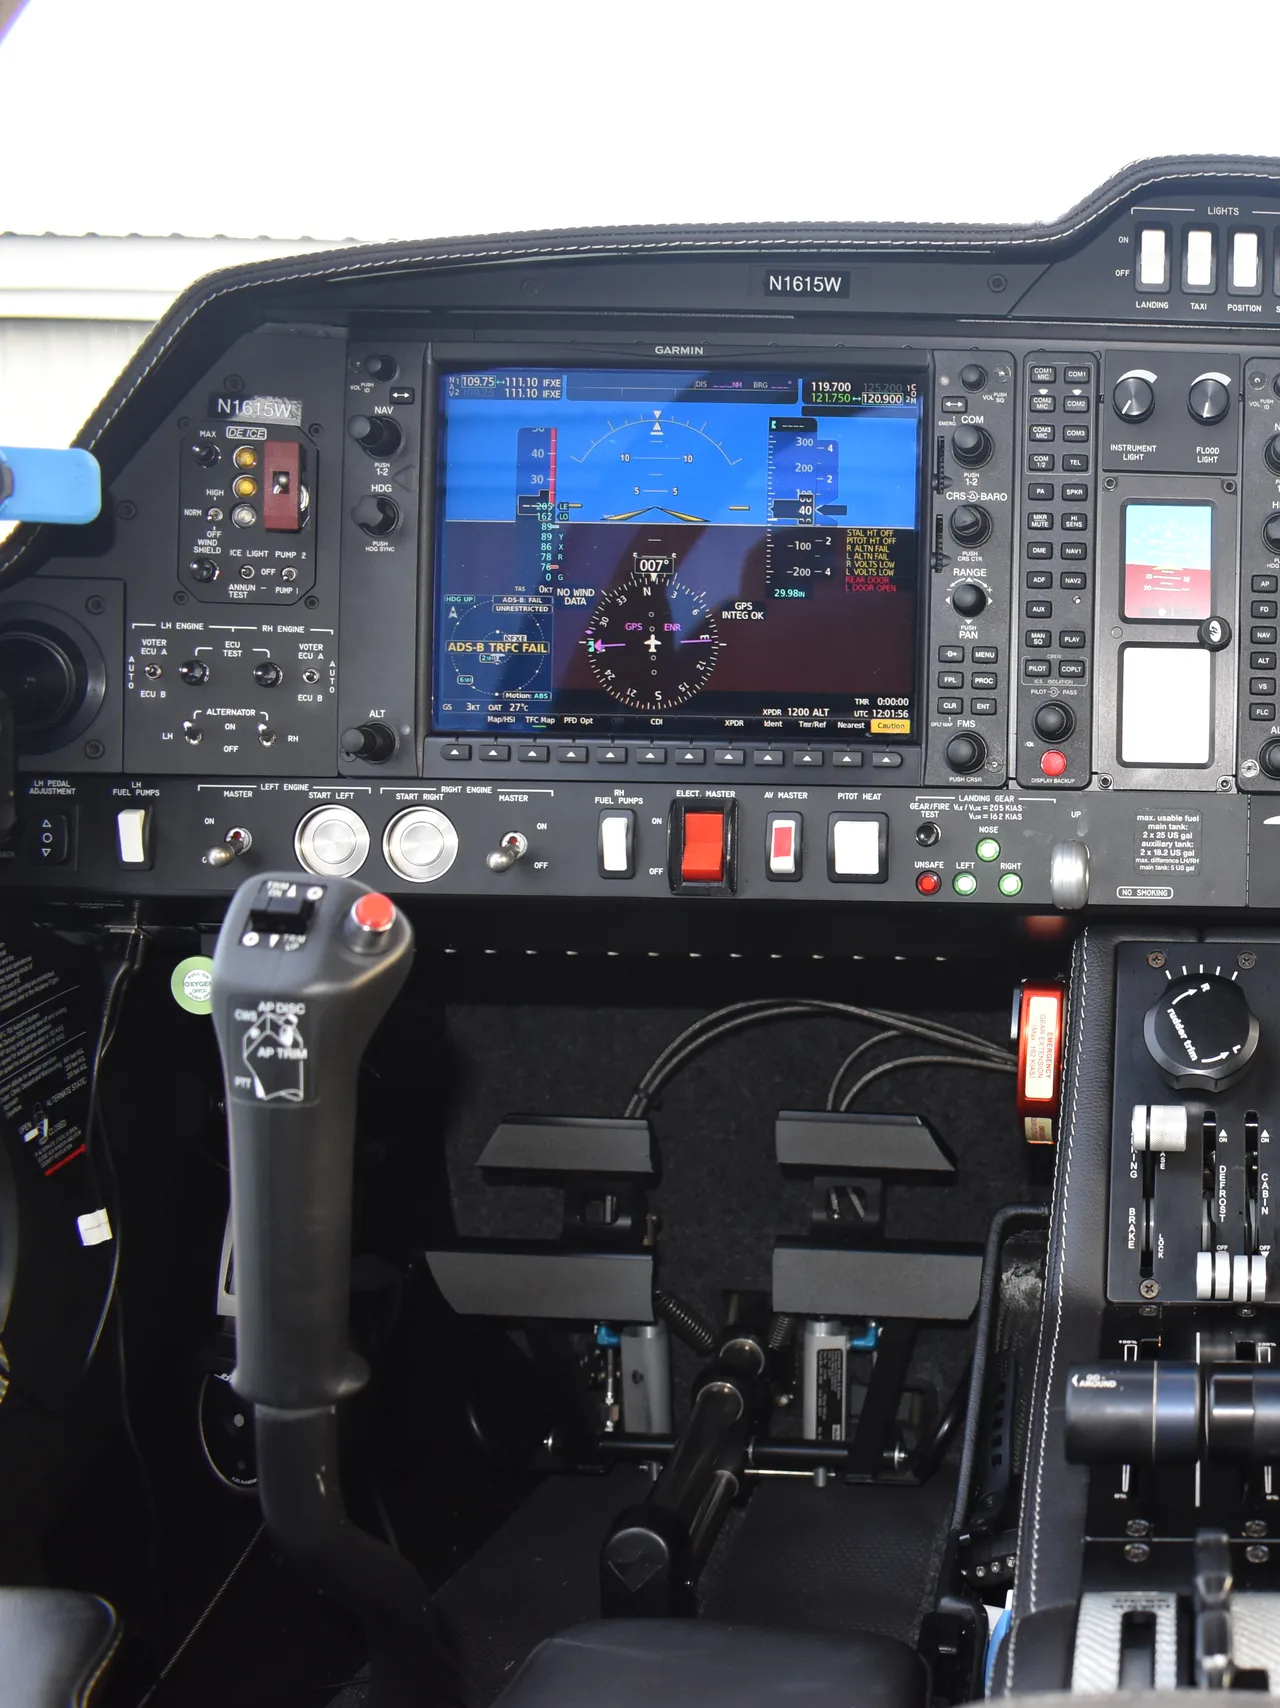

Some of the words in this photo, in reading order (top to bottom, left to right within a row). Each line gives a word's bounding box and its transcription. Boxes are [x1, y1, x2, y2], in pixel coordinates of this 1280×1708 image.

[1208, 206, 1239, 216] LIGHTS
[1115, 269, 1130, 277] OFF
[770, 275, 842, 292] N1615W
[1136, 301, 1169, 309] LANDING
[1190, 302, 1207, 310] TAXI
[1227, 304, 1262, 312] POSITION
[655, 346, 703, 355] GARMIN
[812, 382, 851, 392] 119.700
[218, 396, 292, 418] N1615W
[374, 406, 394, 414] NAV
[961, 415, 984, 424] COM
[1110, 444, 1157, 452] INSTRUMENT
[1196, 446, 1220, 455] FLOOD
[1123, 453, 1144, 461] LIGHT
[371, 484, 392, 492] HDG
[946, 492, 966, 500] CRS
[980, 492, 1008, 501] BARO
[206, 530, 222, 538] OFF
[193, 546, 221, 554] SHIELD
[230, 549, 242, 557] ICE
[953, 568, 987, 577] RANGE
[735, 602, 753, 610] GPS
[722, 611, 748, 619] INTEG
[751, 611, 764, 620] OK
[176, 622, 203, 630] ENGINE
[277, 625, 304, 633] ENGINE
[959, 630, 978, 639] PAN
[448, 642, 484, 652] ADS-B
[488, 643, 519, 652] TRFC
[522, 643, 547, 653] FAIL
[206, 708, 256, 716] ALTERNATOR
[369, 709, 386, 718] ALT
[788, 708, 810, 716] 1200
[812, 708, 830, 716] ALT
[872, 709, 909, 718] 12:01:56
[837, 721, 865, 729] Nearest
[877, 722, 905, 730] Caution
[957, 720, 976, 728] FMS
[284, 783, 309, 791] ENGINE
[466, 786, 492, 794] ENGINE
[224, 790, 253, 798] MASTER
[706, 790, 735, 798] MASTER
[838, 792, 858, 800] PITOT
[959, 794, 990, 802] LANDING
[909, 802, 950, 810] GEAR/FIRE
[921, 810, 939, 818] TEST
[1157, 814, 1183, 822] usable
[1000, 862, 1022, 870] RIGHT
[1167, 1008, 1188, 1042] rudder
[1184, 1040, 1198, 1061] trim
[257, 1047, 274, 1058] AP
[277, 1047, 307, 1059] TRIM
[1219, 1165, 1227, 1222] DEFROST
[1261, 1173, 1269, 1215] CABIN
[1128, 1207, 1136, 1249] BRAKE
